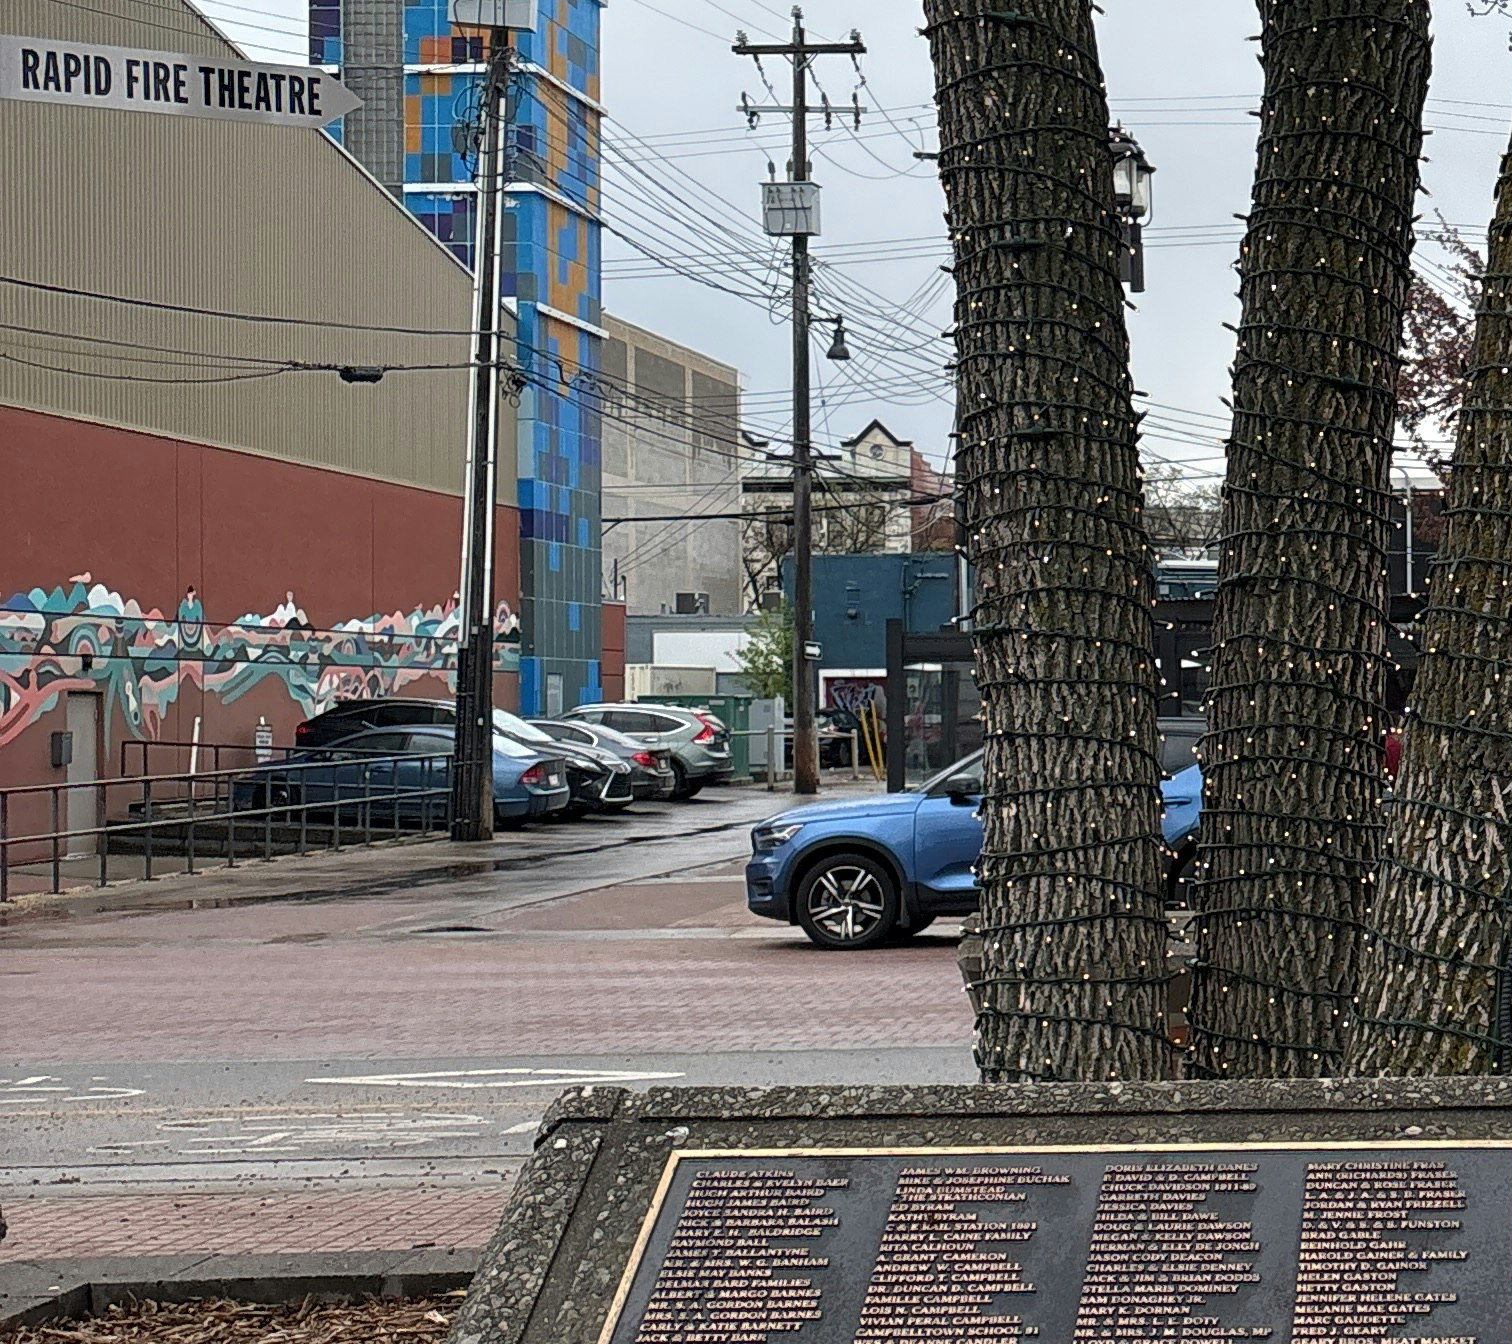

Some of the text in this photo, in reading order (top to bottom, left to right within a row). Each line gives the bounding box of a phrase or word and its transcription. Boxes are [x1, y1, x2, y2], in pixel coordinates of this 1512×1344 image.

[22, 48, 322, 116] RAPID FIRE THEATRE
